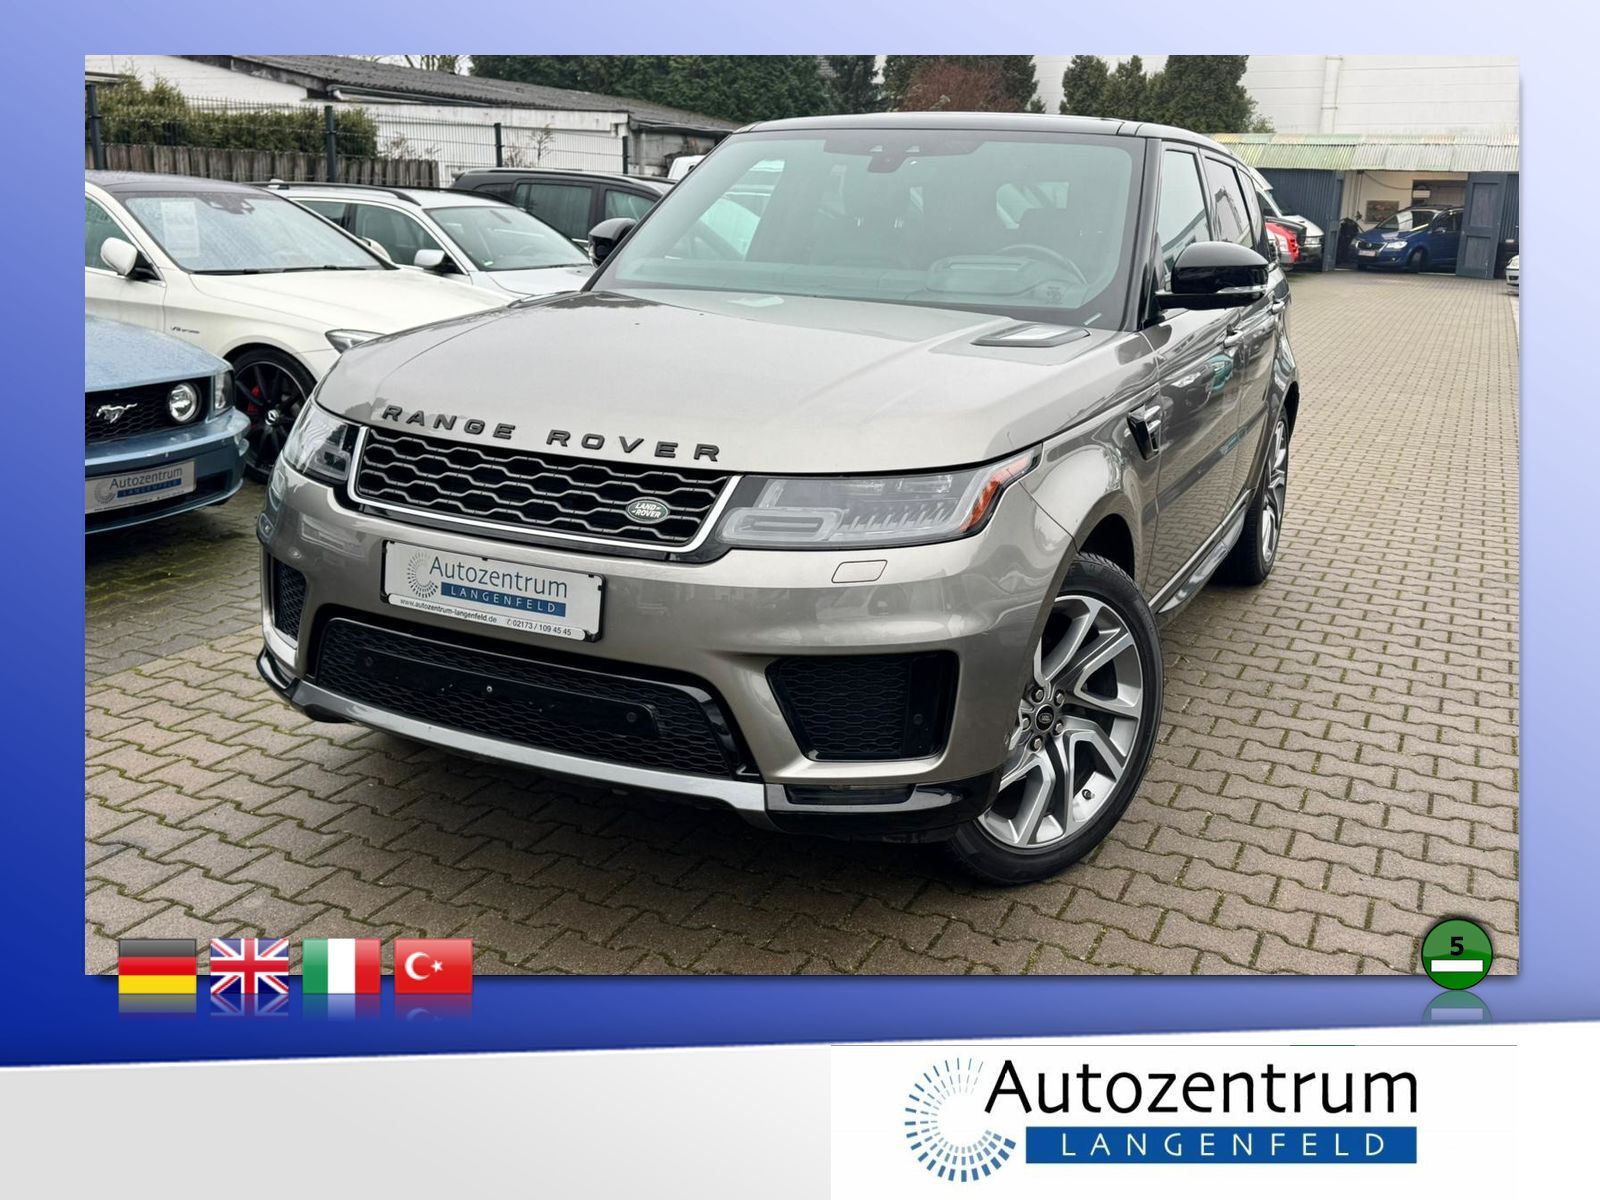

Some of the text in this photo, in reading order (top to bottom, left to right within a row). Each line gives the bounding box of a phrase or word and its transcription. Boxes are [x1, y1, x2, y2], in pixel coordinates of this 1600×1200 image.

[381, 405, 721, 462] RANGE ROVER
[109, 466, 183, 490] Autozentrum
[429, 556, 568, 598] Autozentrum
[399, 599, 498, 624] www.autozentrum-langenfeld.de
[450, 585, 556, 613] LANGENFELD
